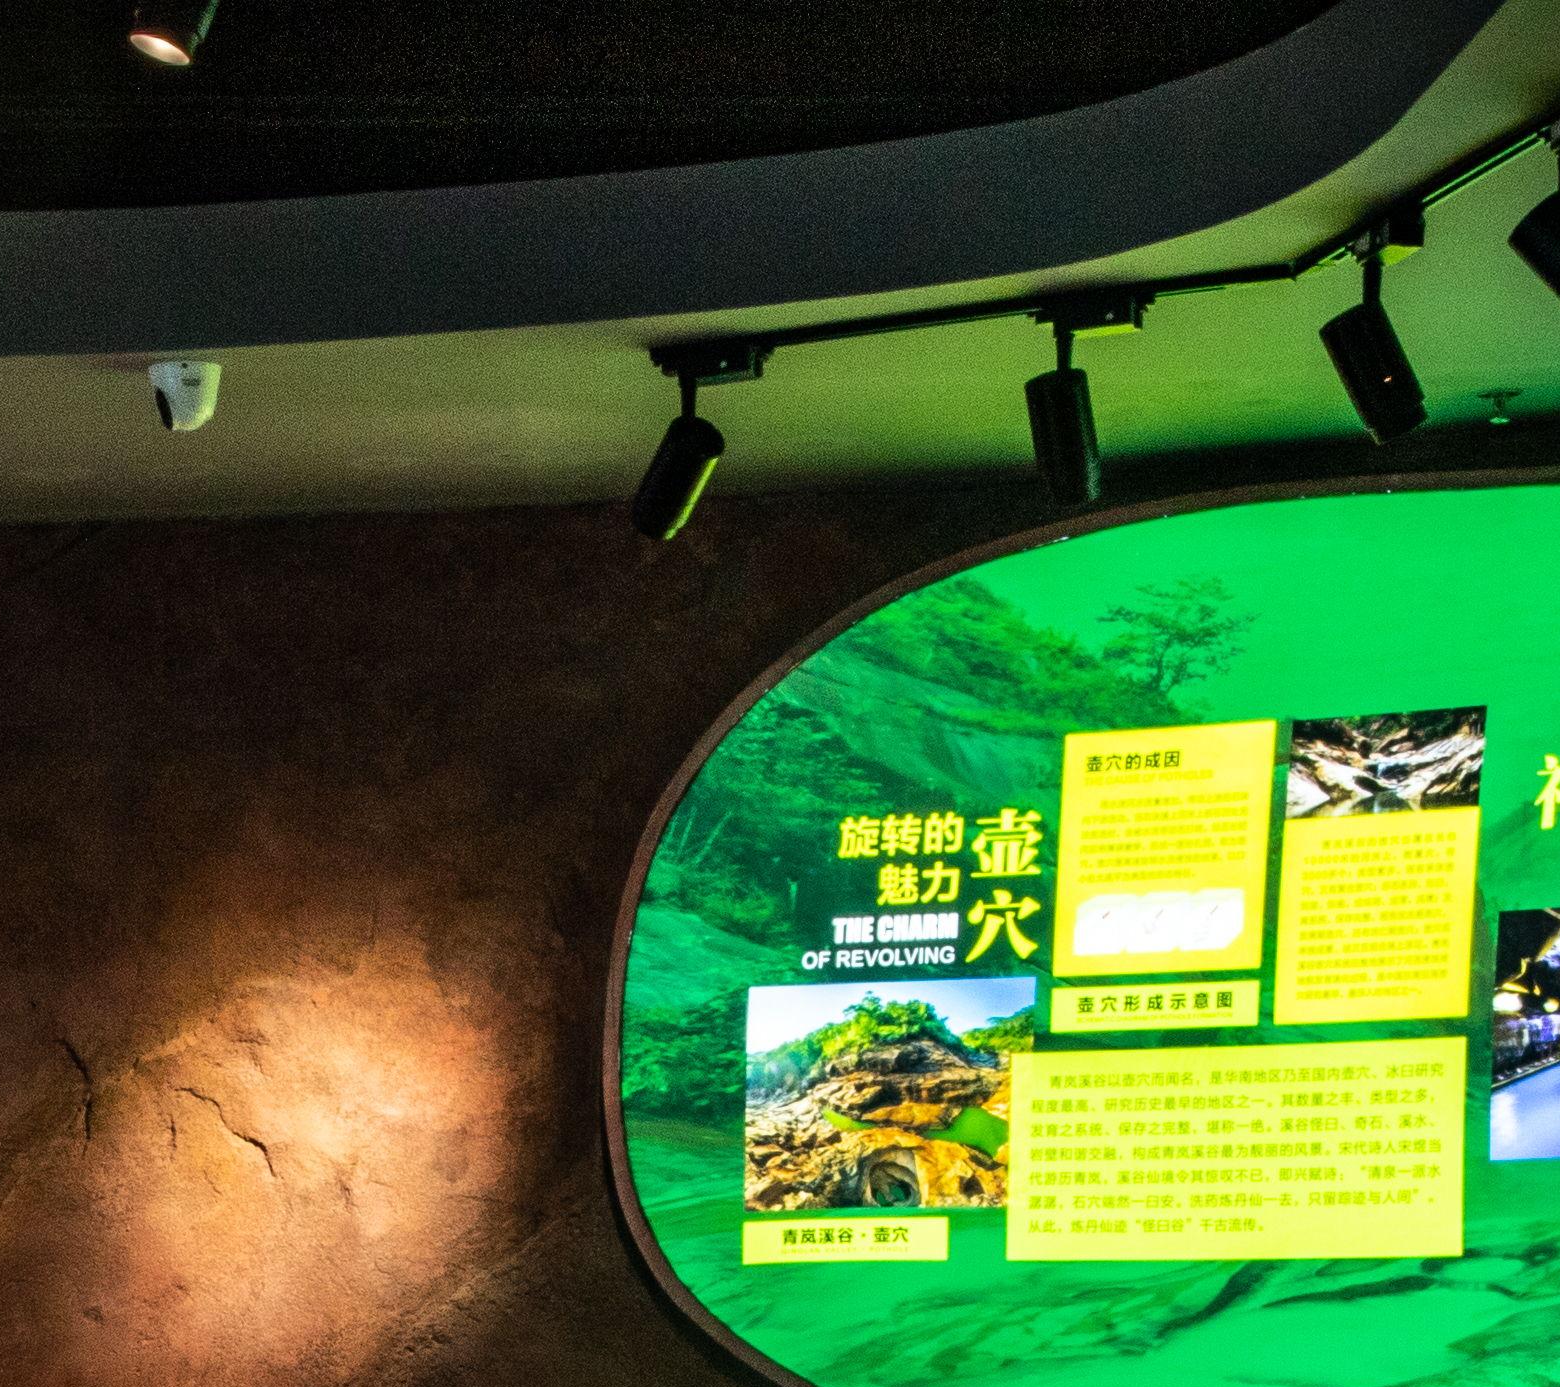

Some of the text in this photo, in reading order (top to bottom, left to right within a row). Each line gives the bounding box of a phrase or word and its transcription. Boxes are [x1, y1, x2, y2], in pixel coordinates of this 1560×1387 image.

[1086, 750, 1181, 773] 壶穴的成因
[838, 809, 963, 859] 旋转的
[877, 861, 961, 906] 魅力
[966, 807, 1043, 963] 壶穴
[832, 912, 959, 943] THE CHARM
[801, 944, 957, 969] OF REVOLVING
[1077, 990, 1234, 1015] 壶穴形成示意图
[782, 1227, 909, 1245] 青岚溪谷·壶穴
